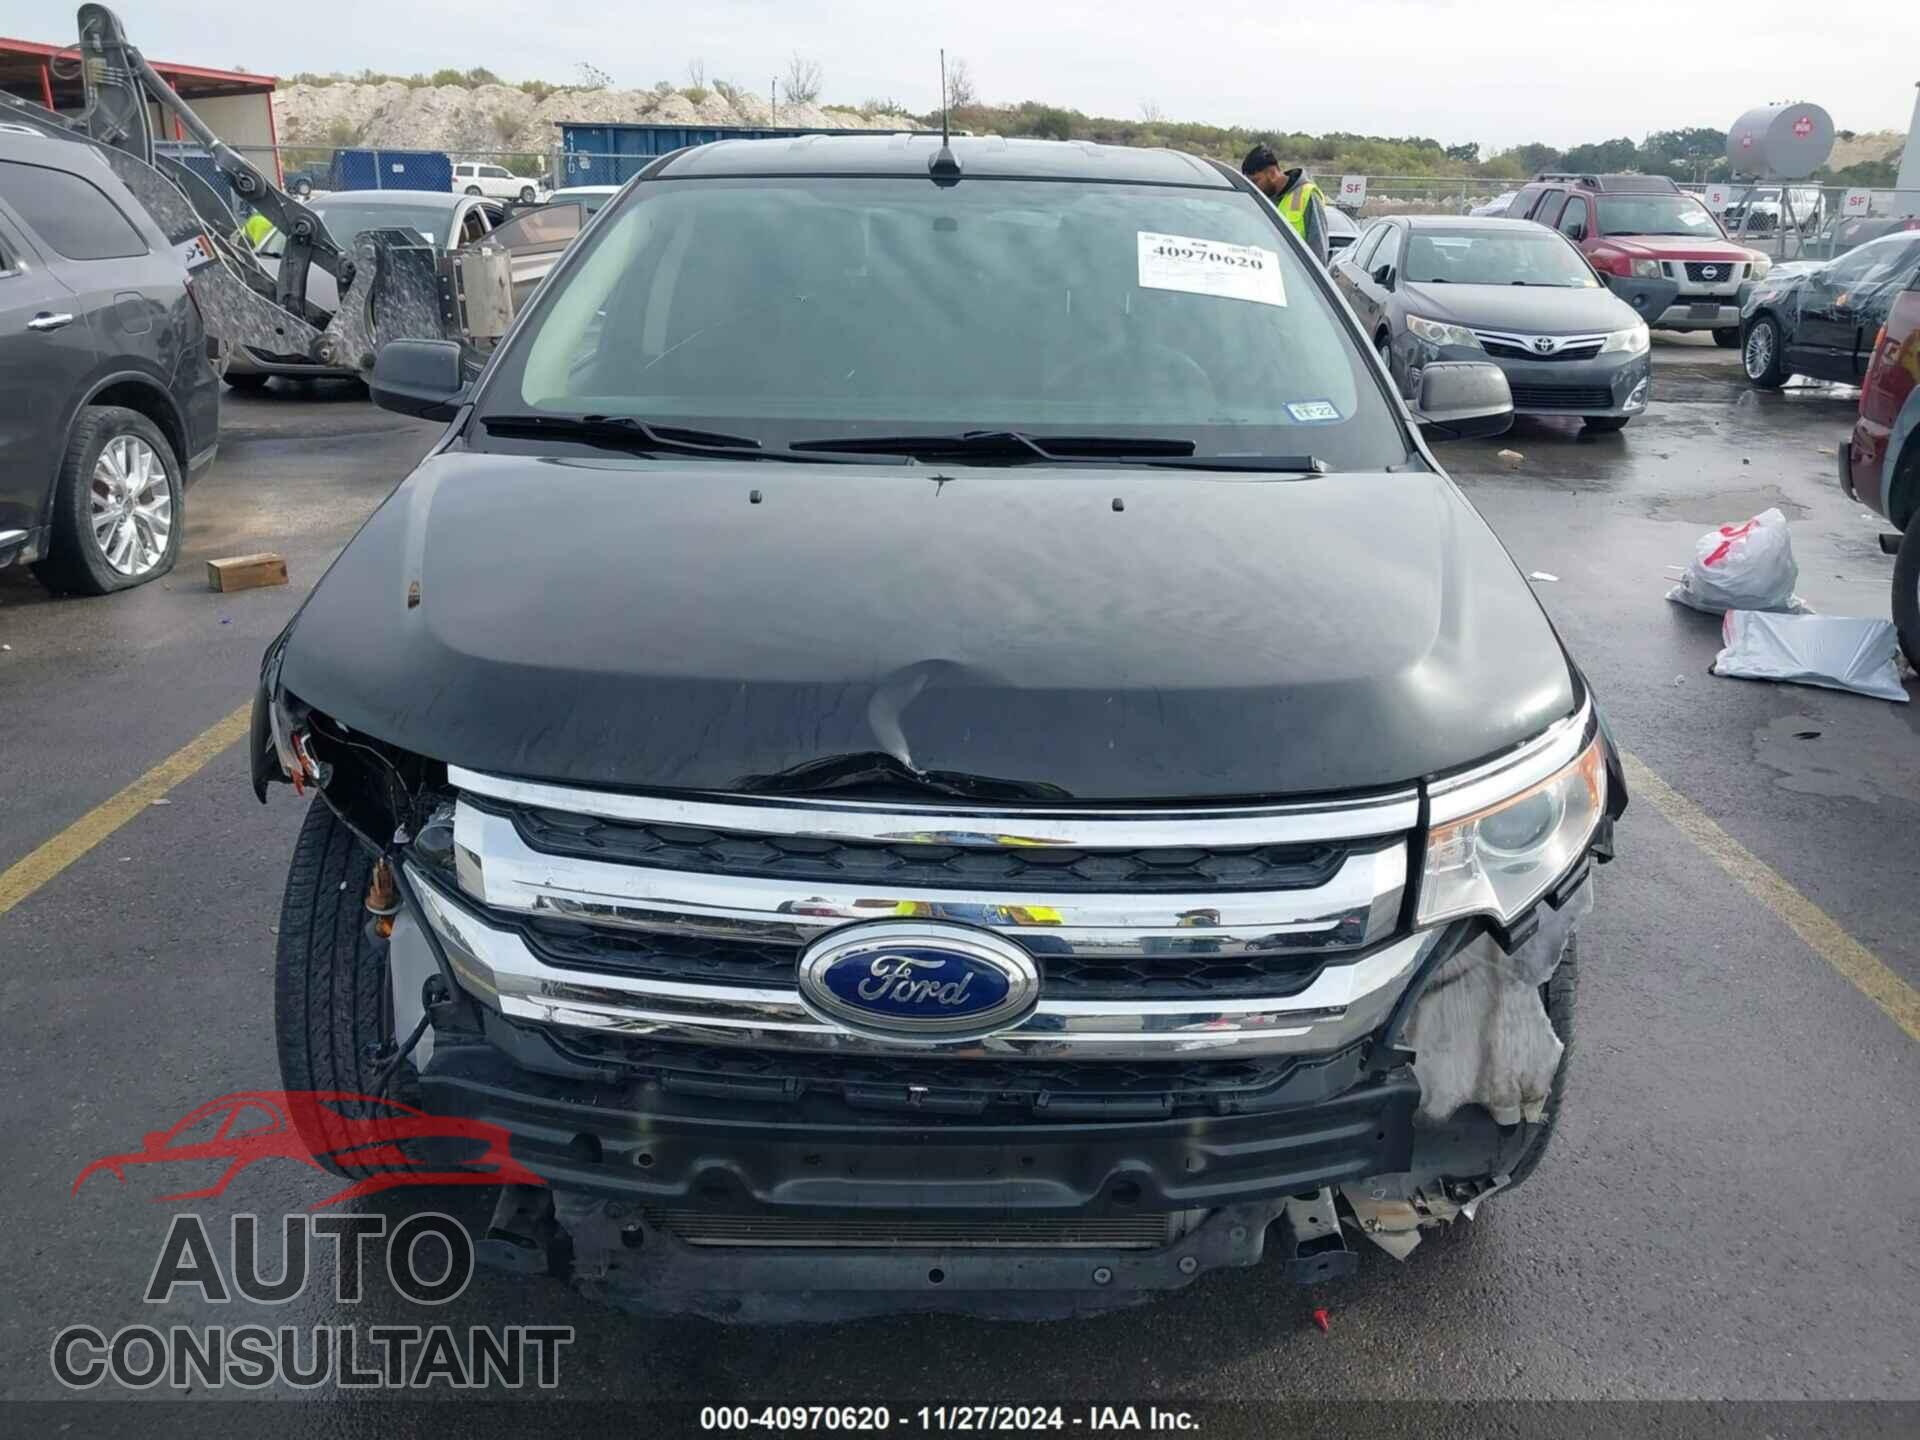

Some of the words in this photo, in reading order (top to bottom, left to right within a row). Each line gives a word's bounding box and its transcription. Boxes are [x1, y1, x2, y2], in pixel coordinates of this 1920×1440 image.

[1345, 183, 1361, 193] SF
[1849, 196, 1865, 206] SF
[1152, 245, 1264, 270] 40970620
[857, 954, 974, 1005] Ford
